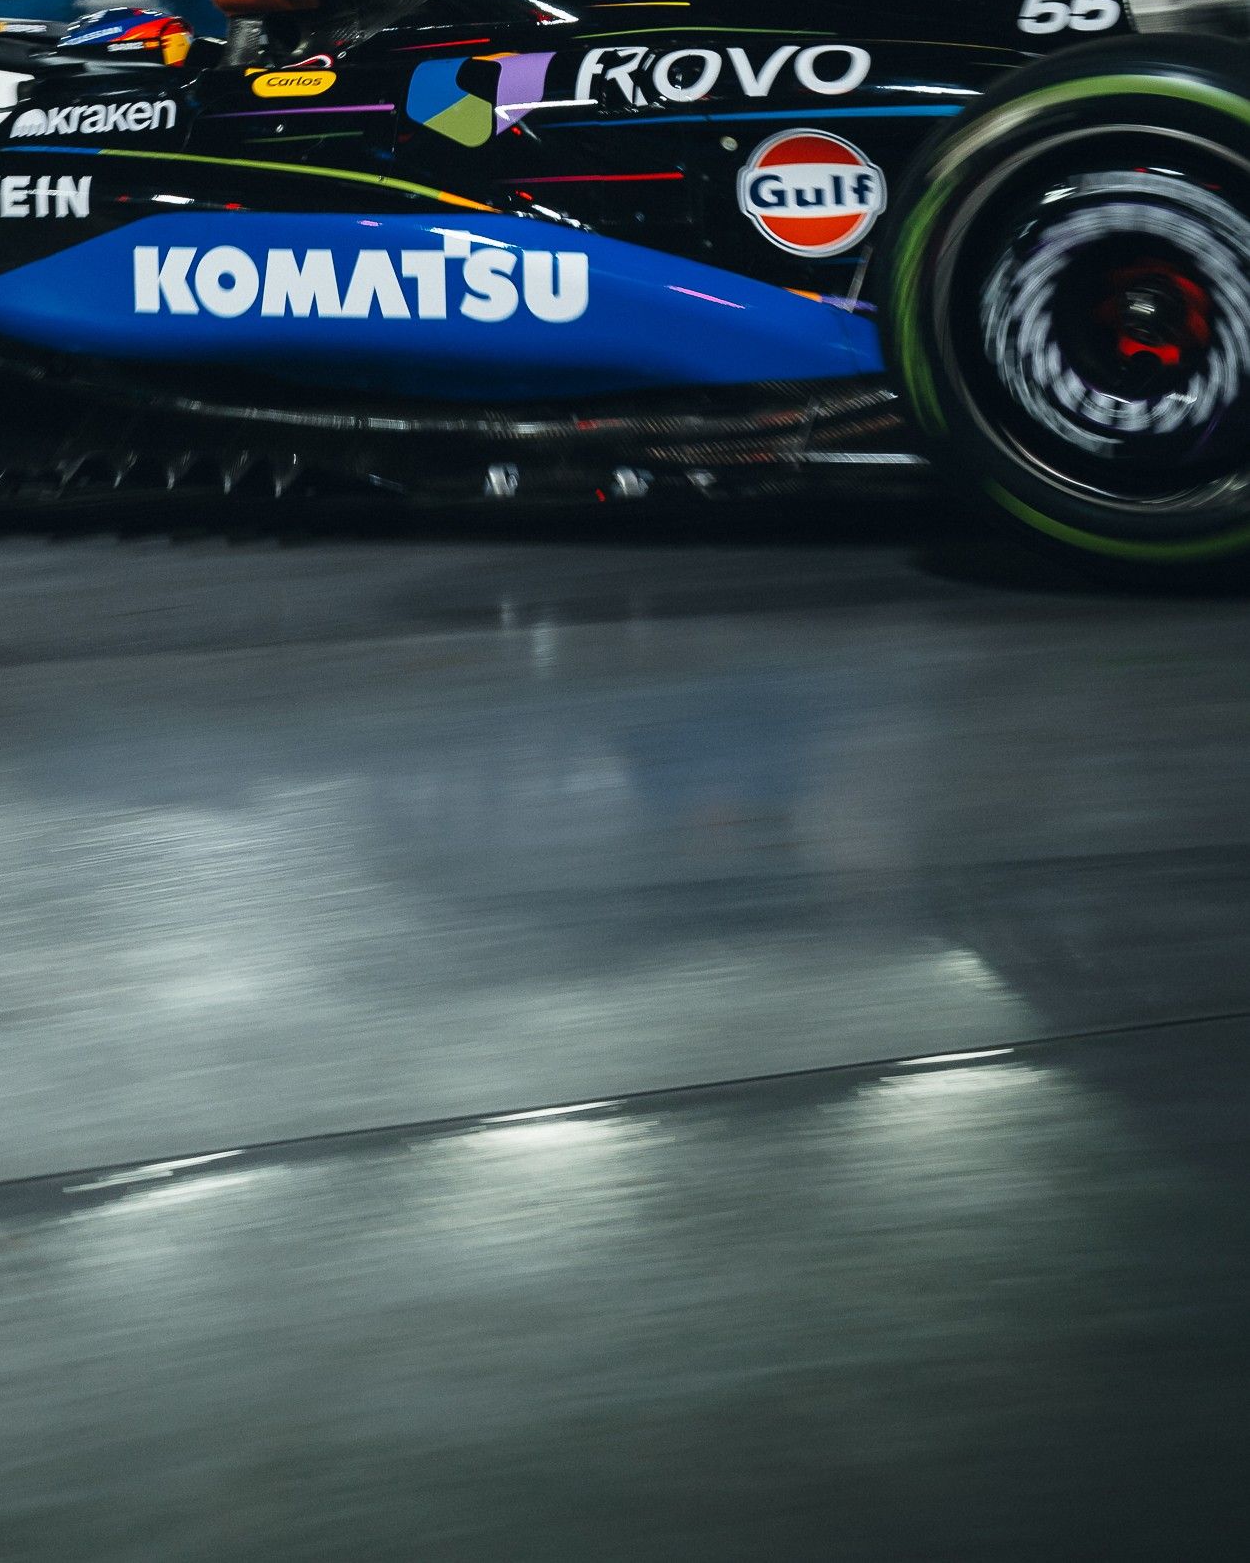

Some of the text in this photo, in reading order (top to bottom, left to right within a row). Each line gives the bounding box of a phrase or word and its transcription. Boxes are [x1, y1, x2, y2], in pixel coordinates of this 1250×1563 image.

[266, 76, 322, 87] Carlos
[575, 44, 871, 106] ROVO
[46, 99, 177, 135] kraken
[750, 173, 873, 208] Gulf
[134, 230, 588, 323] KOMATSU
